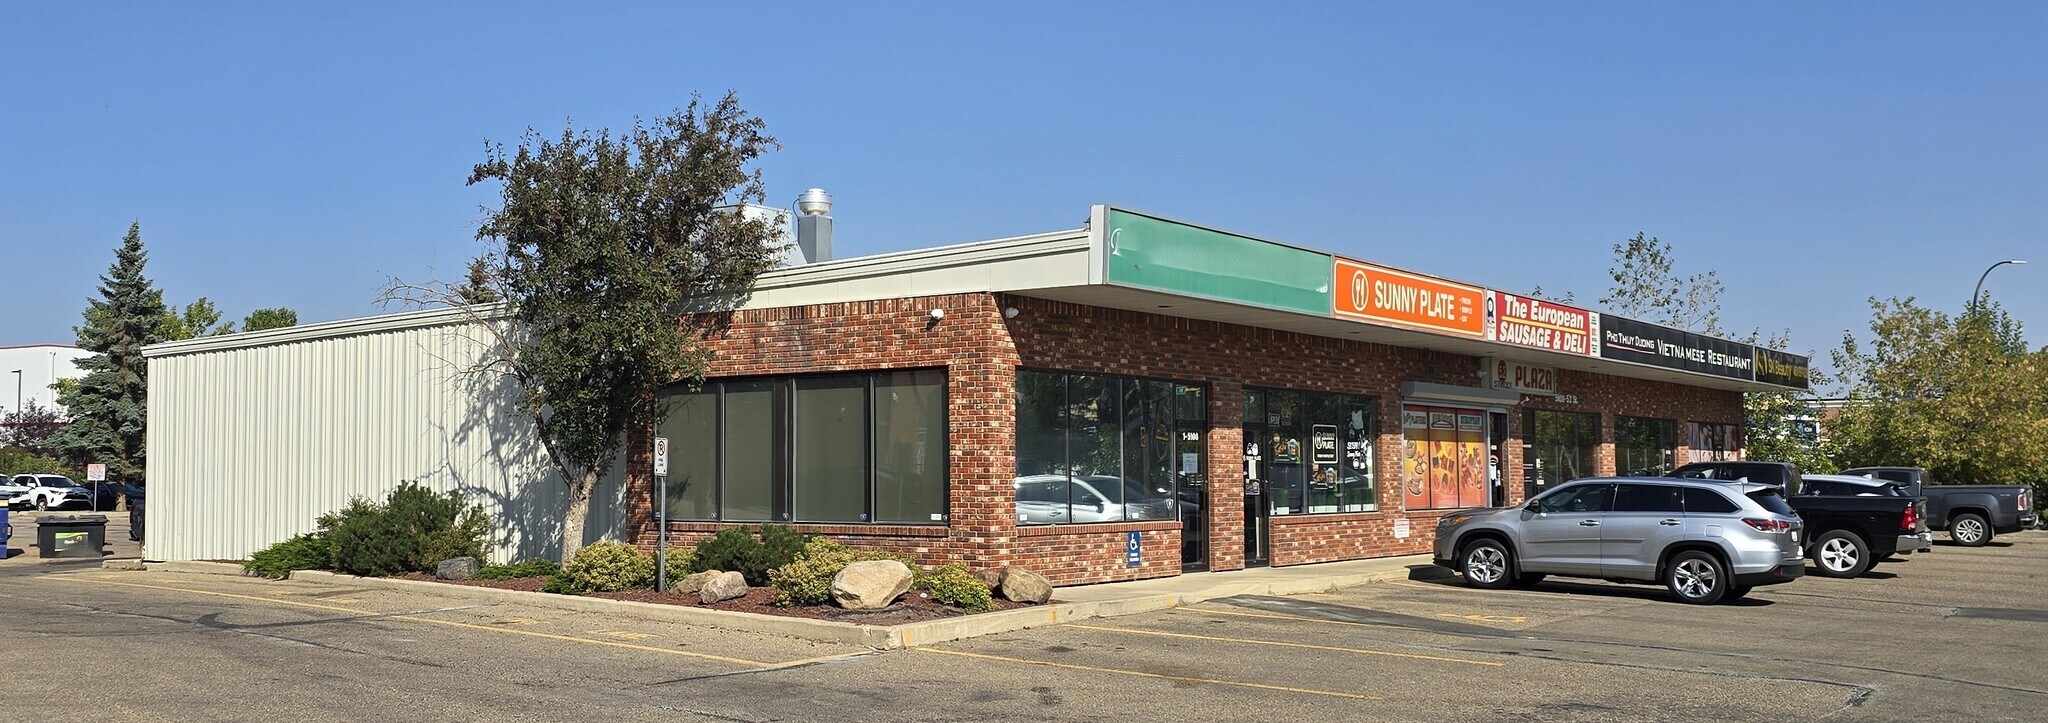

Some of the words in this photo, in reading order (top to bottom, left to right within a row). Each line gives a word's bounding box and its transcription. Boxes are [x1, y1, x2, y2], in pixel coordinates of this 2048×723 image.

[1374, 279, 1418, 314] SUNNY
[1420, 289, 1456, 321] PLATE
[1504, 295, 1528, 319] The
[1530, 300, 1584, 330] European
[1500, 321, 1551, 348] SAUSAGE
[1553, 329, 1561, 350] &
[1563, 332, 1587, 354] DELI
[1657, 339, 1706, 363] VIETNAMESE
[1707, 349, 1752, 371] RESTAURANT
[1514, 365, 1553, 391] PLAZA
[1322, 432, 1335, 441] SUNNY
[1322, 441, 1335, 449] PLATE
